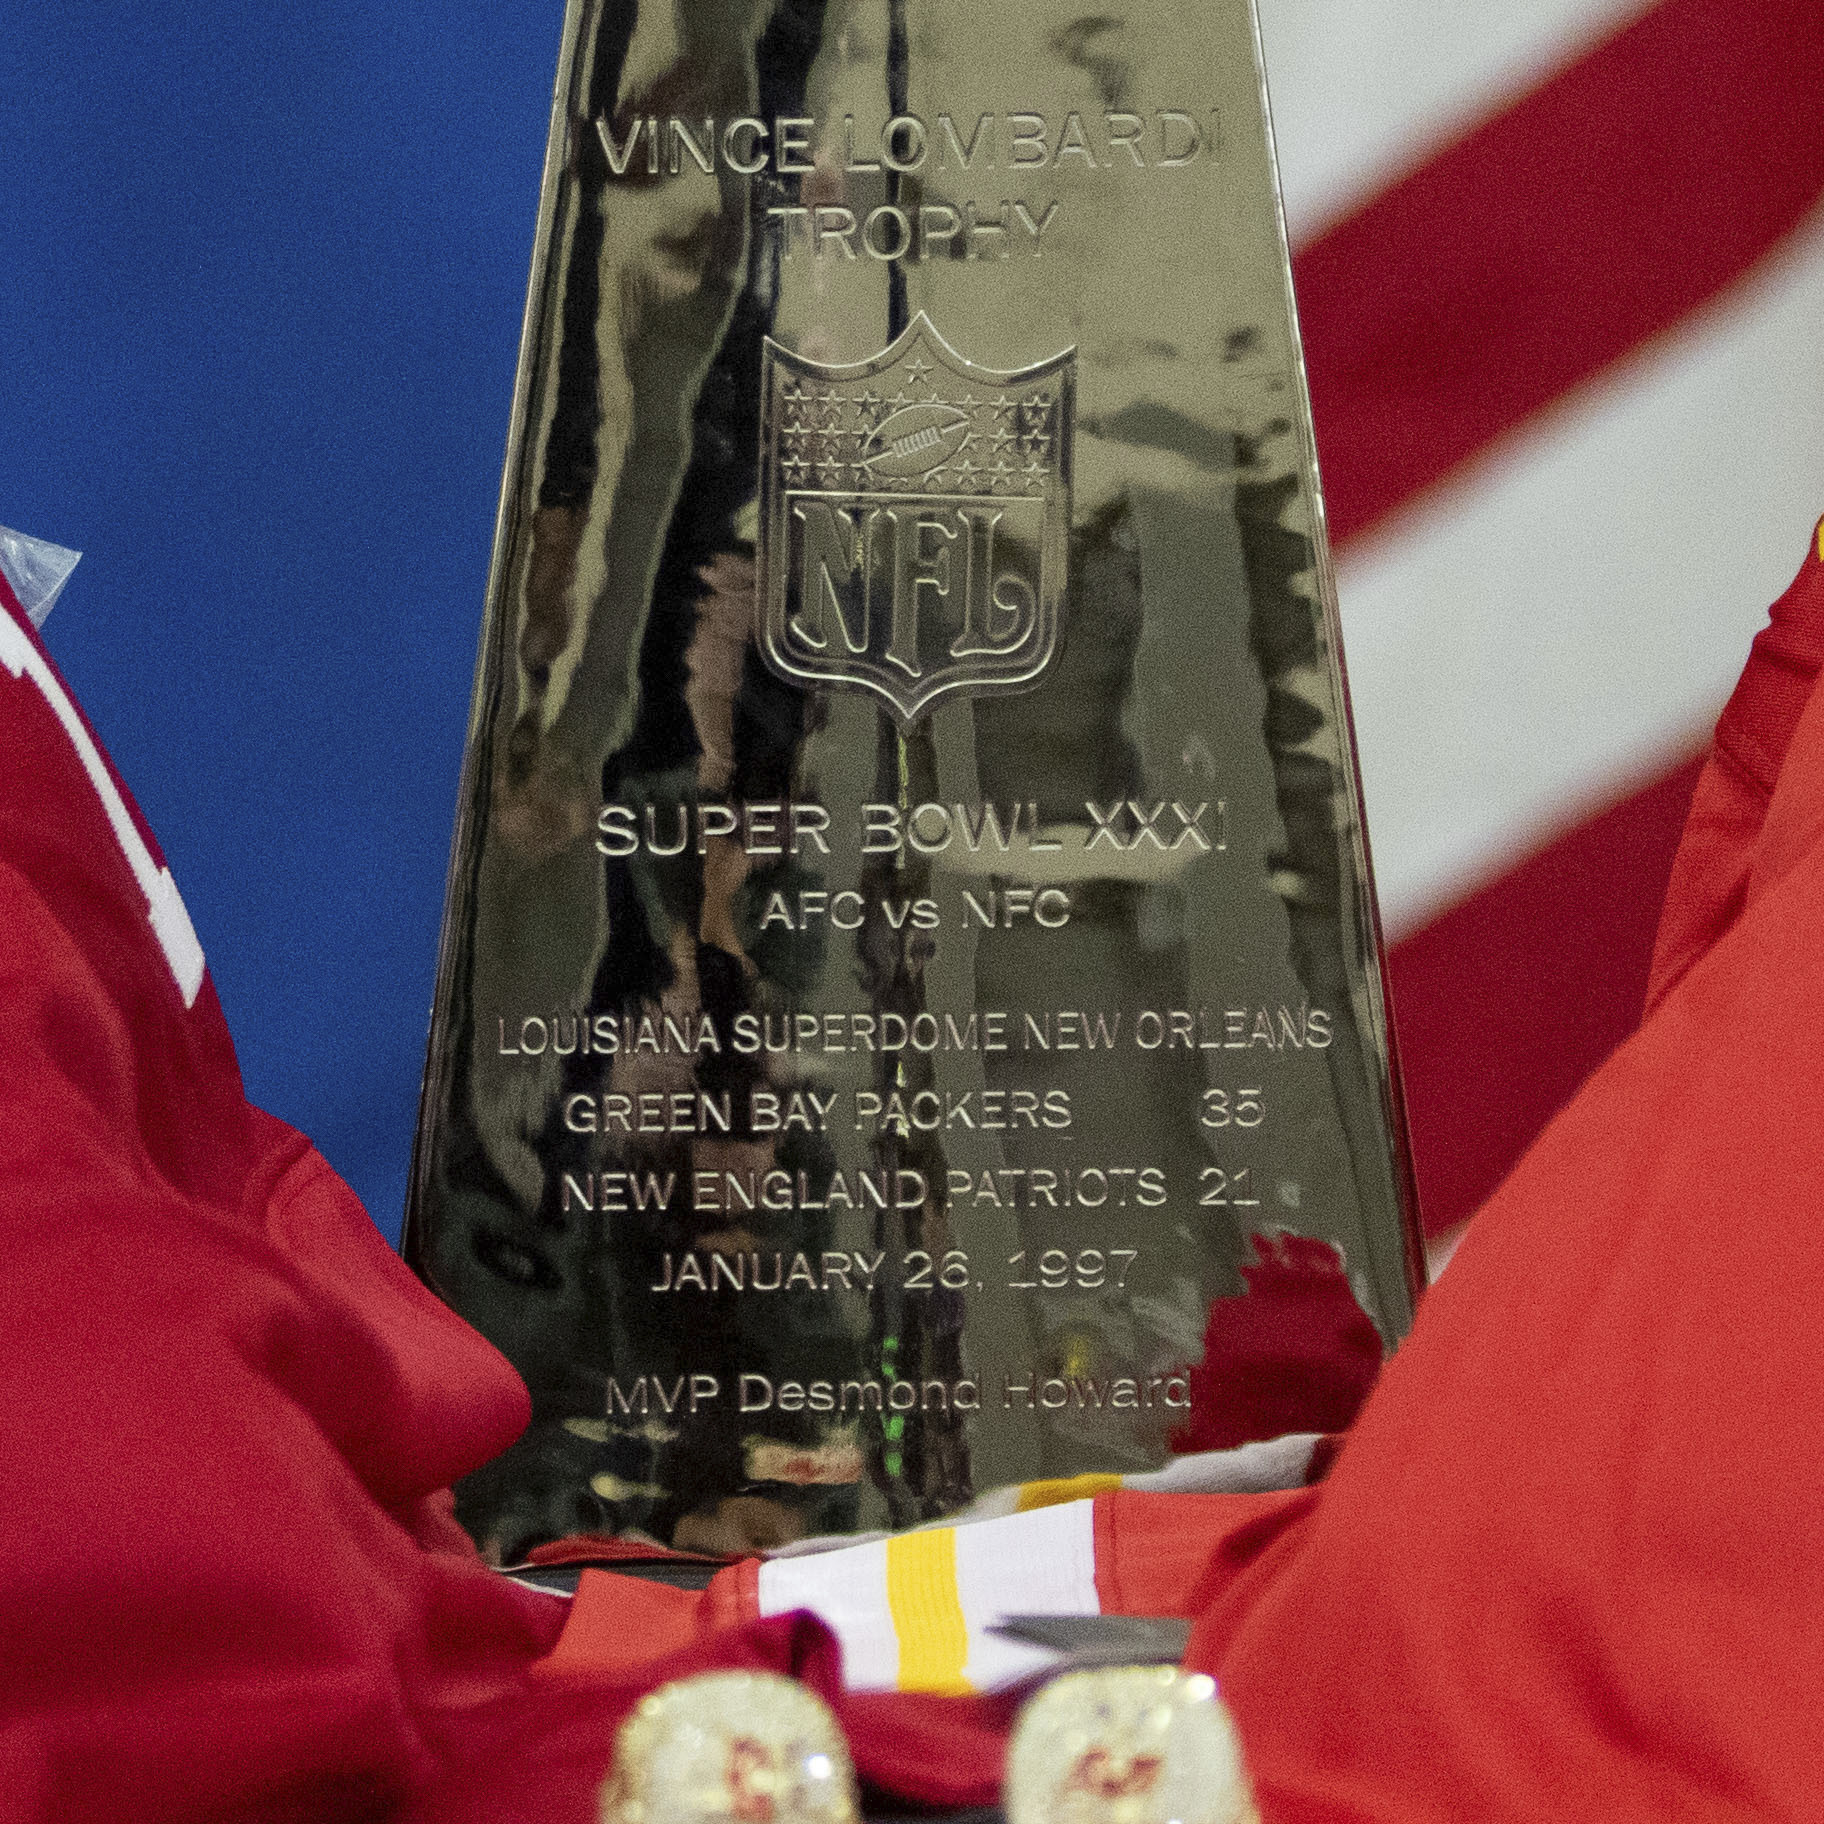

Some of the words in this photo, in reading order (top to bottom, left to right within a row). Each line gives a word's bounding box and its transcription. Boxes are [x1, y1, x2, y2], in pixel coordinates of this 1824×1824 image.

[596, 114, 817, 176] VINCE
[842, 106, 1223, 174] LOMBARDI
[766, 200, 1060, 263] TROPHY
[788, 504, 1038, 679] NFL
[594, 802, 830, 859] SUPER
[861, 800, 1062, 854] BOWL
[1084, 798, 1228, 852] XXXI
[760, 889, 866, 931] AFC
[882, 896, 940, 931] vs
[961, 888, 1072, 929] NFC
[497, 1014, 721, 1056] LOUISIANA
[732, 1013, 1009, 1054] SUPERDOME
[1022, 1011, 1122, 1052] NEW
[1133, 1006, 1334, 1051] ORLEANS
[564, 1093, 732, 1134] GREEN
[750, 1091, 837, 1133] BAY
[853, 1089, 1074, 1132] PACKERS
[1200, 1087, 1268, 1130] 35
[561, 1171, 676, 1214] NEW
[692, 1170, 927, 1213] ENGLAND
[944, 1166, 1170, 1210] PATRIOTS
[1198, 1167, 1261, 1209] 21
[650, 1250, 888, 1293] JANUARY
[1006, 1248, 1140, 1291] 1997
[604, 1376, 720, 1415] MVP
[737, 1373, 982, 1414] Desmond
[1001, 1371, 1193, 1413] Howard
